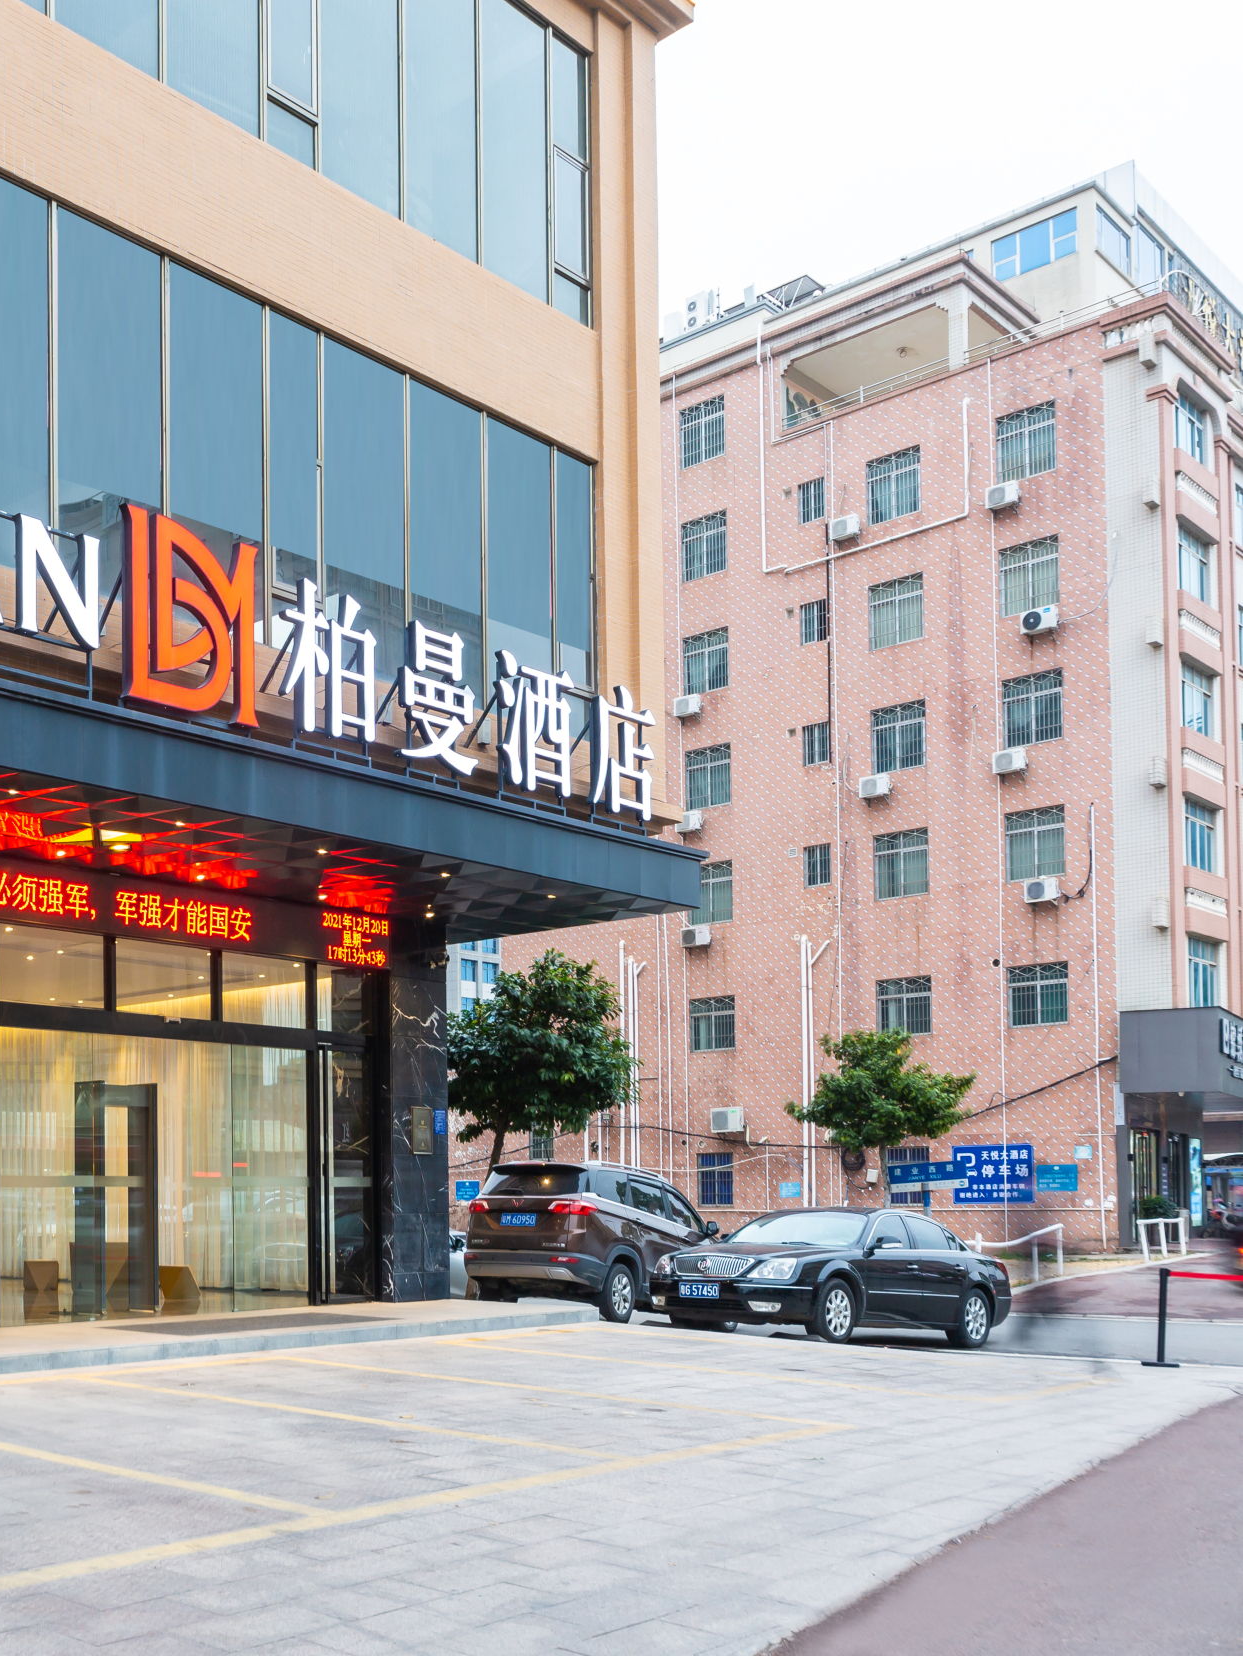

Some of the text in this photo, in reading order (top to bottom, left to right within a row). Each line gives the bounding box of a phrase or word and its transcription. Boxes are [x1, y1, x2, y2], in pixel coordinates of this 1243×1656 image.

[278, 577, 656, 822] 柏曼酒店
[322, 912, 389, 936] 2021年12月20日
[343, 930, 372, 948] 星期一
[981, 1149, 1029, 1161] 天悦大酒店
[894, 1164, 954, 1177] 建业西路
[981, 1163, 1029, 1178] 停车场
